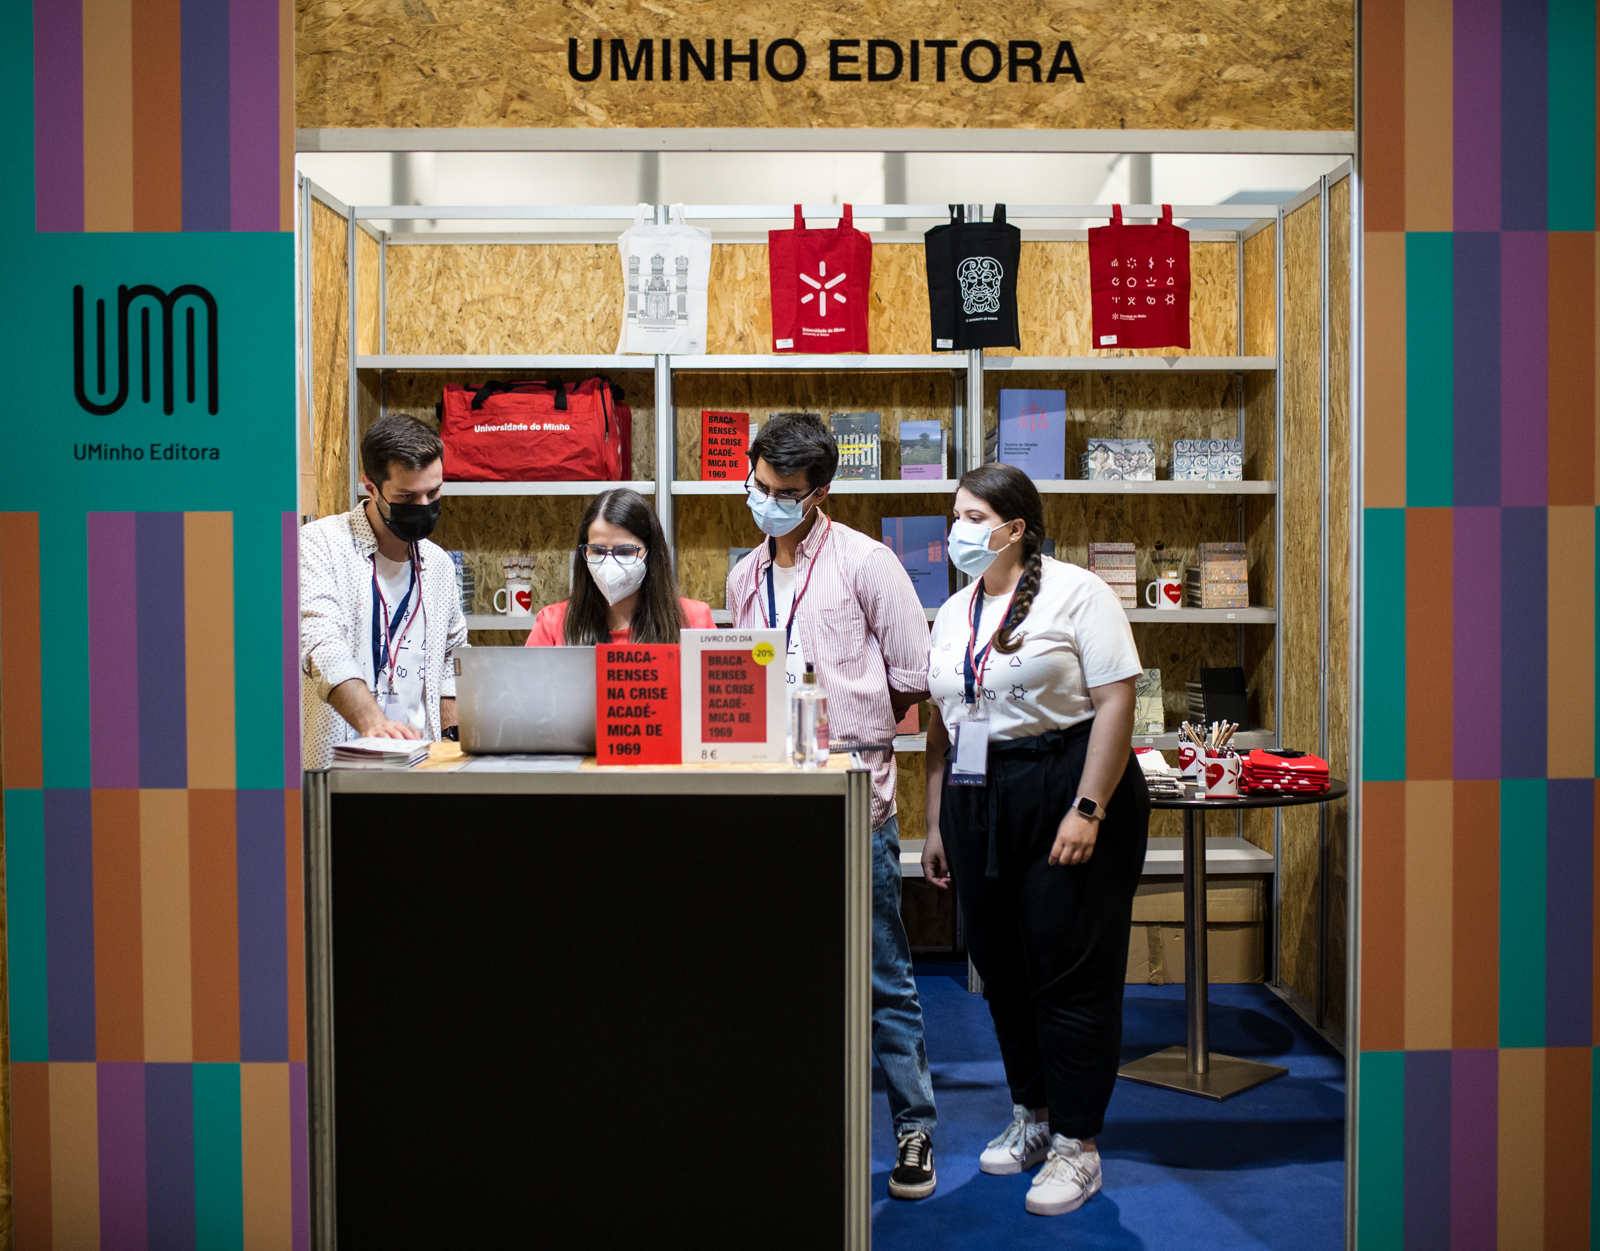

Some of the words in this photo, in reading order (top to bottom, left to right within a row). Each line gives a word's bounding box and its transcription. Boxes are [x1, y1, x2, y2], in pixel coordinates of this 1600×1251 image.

[567, 38, 807, 82] UMINHO
[828, 38, 1086, 84] EDITORA
[708, 416, 737, 424] BRACA-
[474, 423, 528, 433] Universidade
[530, 423, 541, 431] do
[543, 423, 570, 431] Minho
[708, 426, 737, 435] RENSES
[708, 437, 719, 445] NA
[720, 438, 742, 447] CRISE
[73, 443, 145, 461] UMinho
[149, 443, 220, 461] Editora
[708, 448, 735, 457] ACADÉ-
[708, 459, 727, 467] MICA
[729, 460, 739, 468] DE
[708, 470, 727, 478] 1969
[700, 635, 724, 643] LIVRO
[725, 635, 738, 643] DO
[606, 651, 657, 664] BRACA-
[753, 649, 774, 658] -20%
[708, 655, 747, 666] BRACA-
[606, 669, 659, 682] RENSES
[708, 670, 747, 680] RENSES
[606, 687, 626, 700] NA
[629, 687, 668, 700] CRISE
[708, 684, 722, 695] NA
[725, 684, 755, 695] CRISE
[708, 696, 746, 709] ACADÉ-
[606, 702, 657, 718] ACADÉ-
[708, 712, 735, 723] MICA
[738, 712, 751, 723] DE
[606, 724, 641, 737] MICA
[645, 724, 663, 737] DE
[708, 727, 733, 738] 1969
[608, 743, 641, 756] 1969
[701, 749, 708, 760] 8
[710, 749, 718, 760] €
